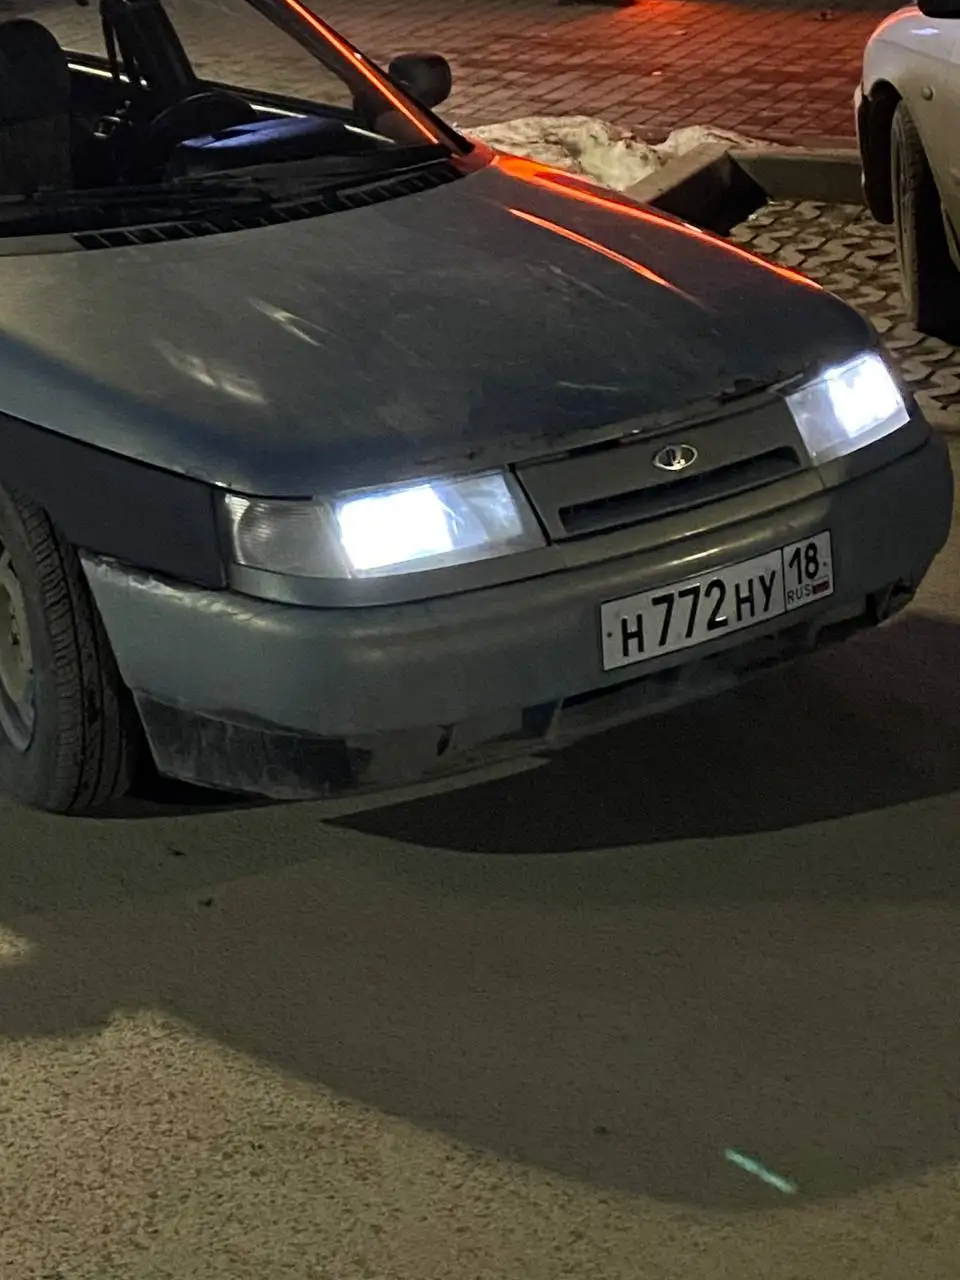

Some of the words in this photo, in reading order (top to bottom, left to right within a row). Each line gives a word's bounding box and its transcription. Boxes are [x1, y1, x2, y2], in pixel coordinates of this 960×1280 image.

[621, 570, 777, 657] Н772НУ
[789, 543, 820, 585] 18
[787, 587, 812, 605] RUS
